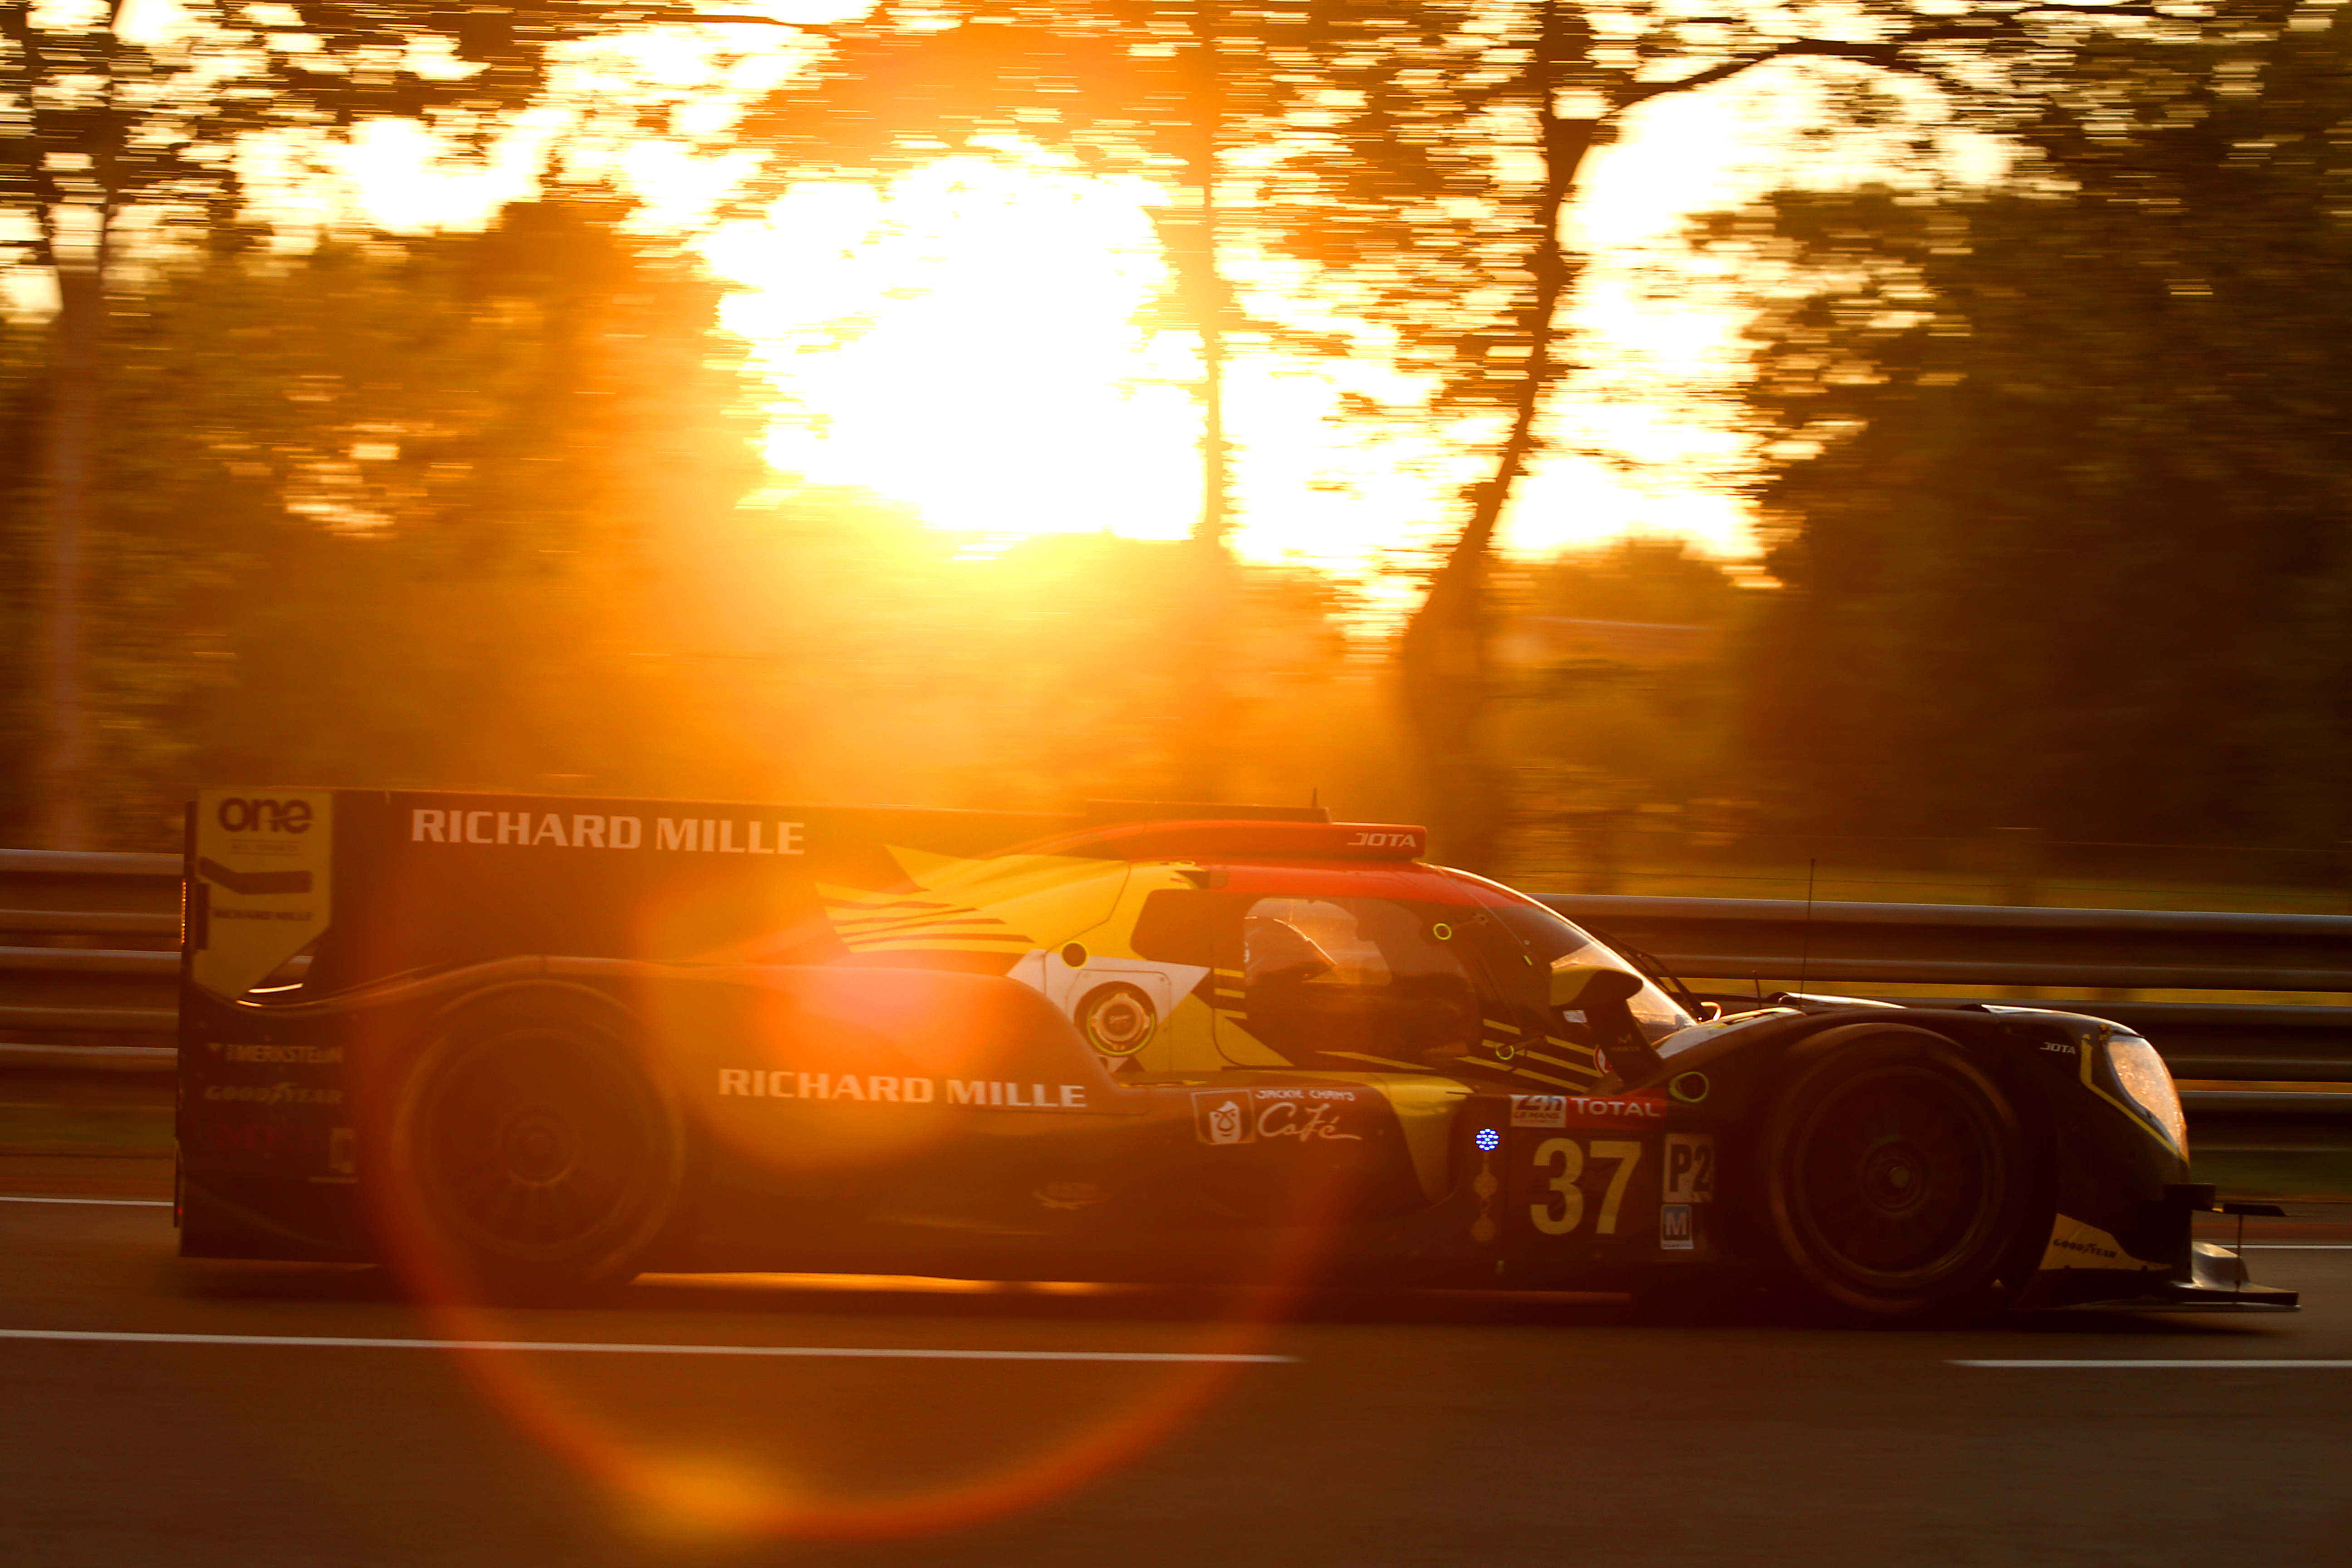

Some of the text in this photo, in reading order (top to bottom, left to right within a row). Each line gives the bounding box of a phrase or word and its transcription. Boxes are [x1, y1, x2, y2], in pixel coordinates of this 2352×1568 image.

[218, 797, 314, 834] one
[411, 808, 805, 855] RICHARD MILLE
[1347, 833, 1416, 847] JOTA
[2038, 1041, 2076, 1055] JOTA
[205, 1082, 343, 1105] GOODYEAR
[718, 1068, 1088, 1108] RICHARD MILLE
[1570, 1097, 1661, 1117] TOTAL
[1670, 1144, 1711, 1192] P2
[1529, 1137, 1642, 1235] 37
[1666, 1212, 1688, 1236] M
[2053, 1238, 2117, 1259] GOODYEAR
